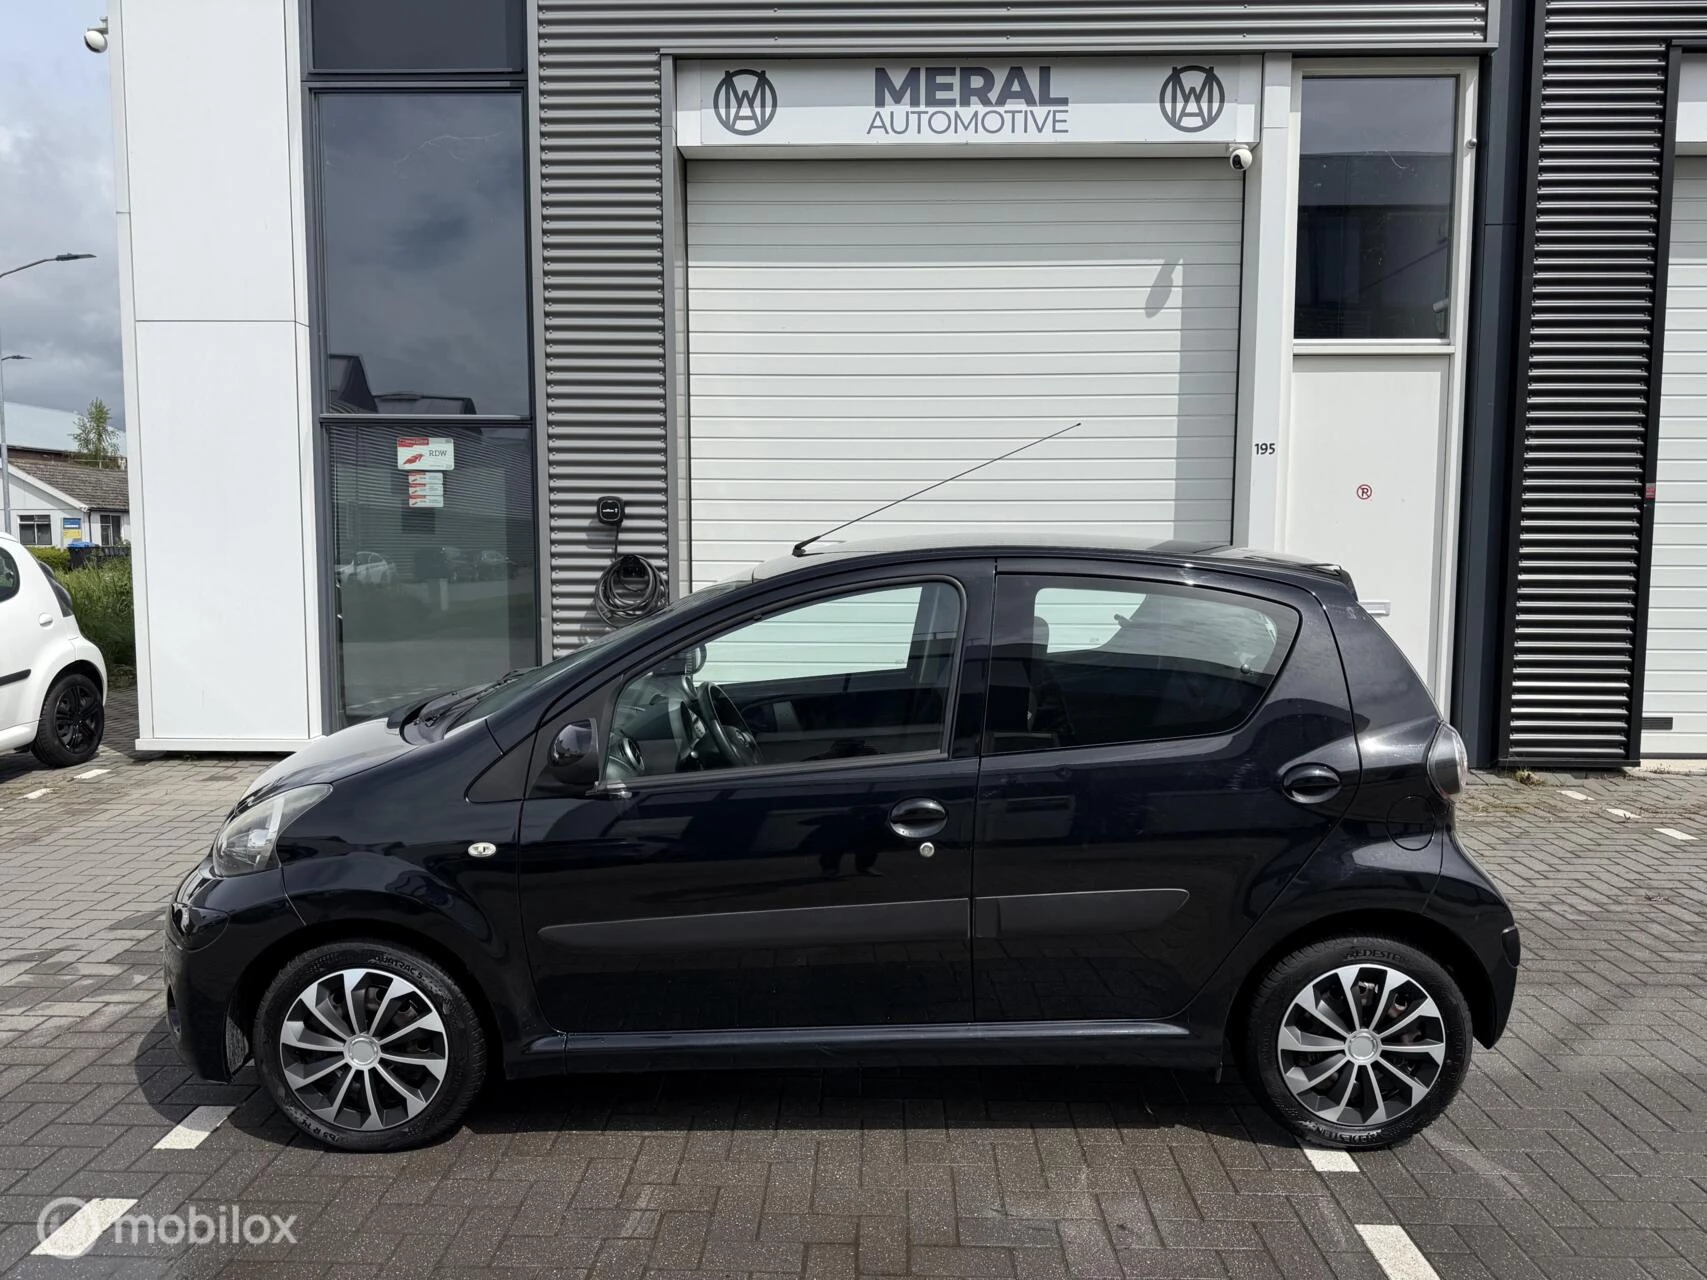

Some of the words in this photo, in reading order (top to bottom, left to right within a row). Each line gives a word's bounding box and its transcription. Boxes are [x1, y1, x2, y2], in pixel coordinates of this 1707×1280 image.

[874, 66, 1069, 108] MERAL
[866, 110, 1069, 135] AUTOMOTIVE
[428, 449, 448, 457] RDW
[1254, 442, 1276, 455] 195
